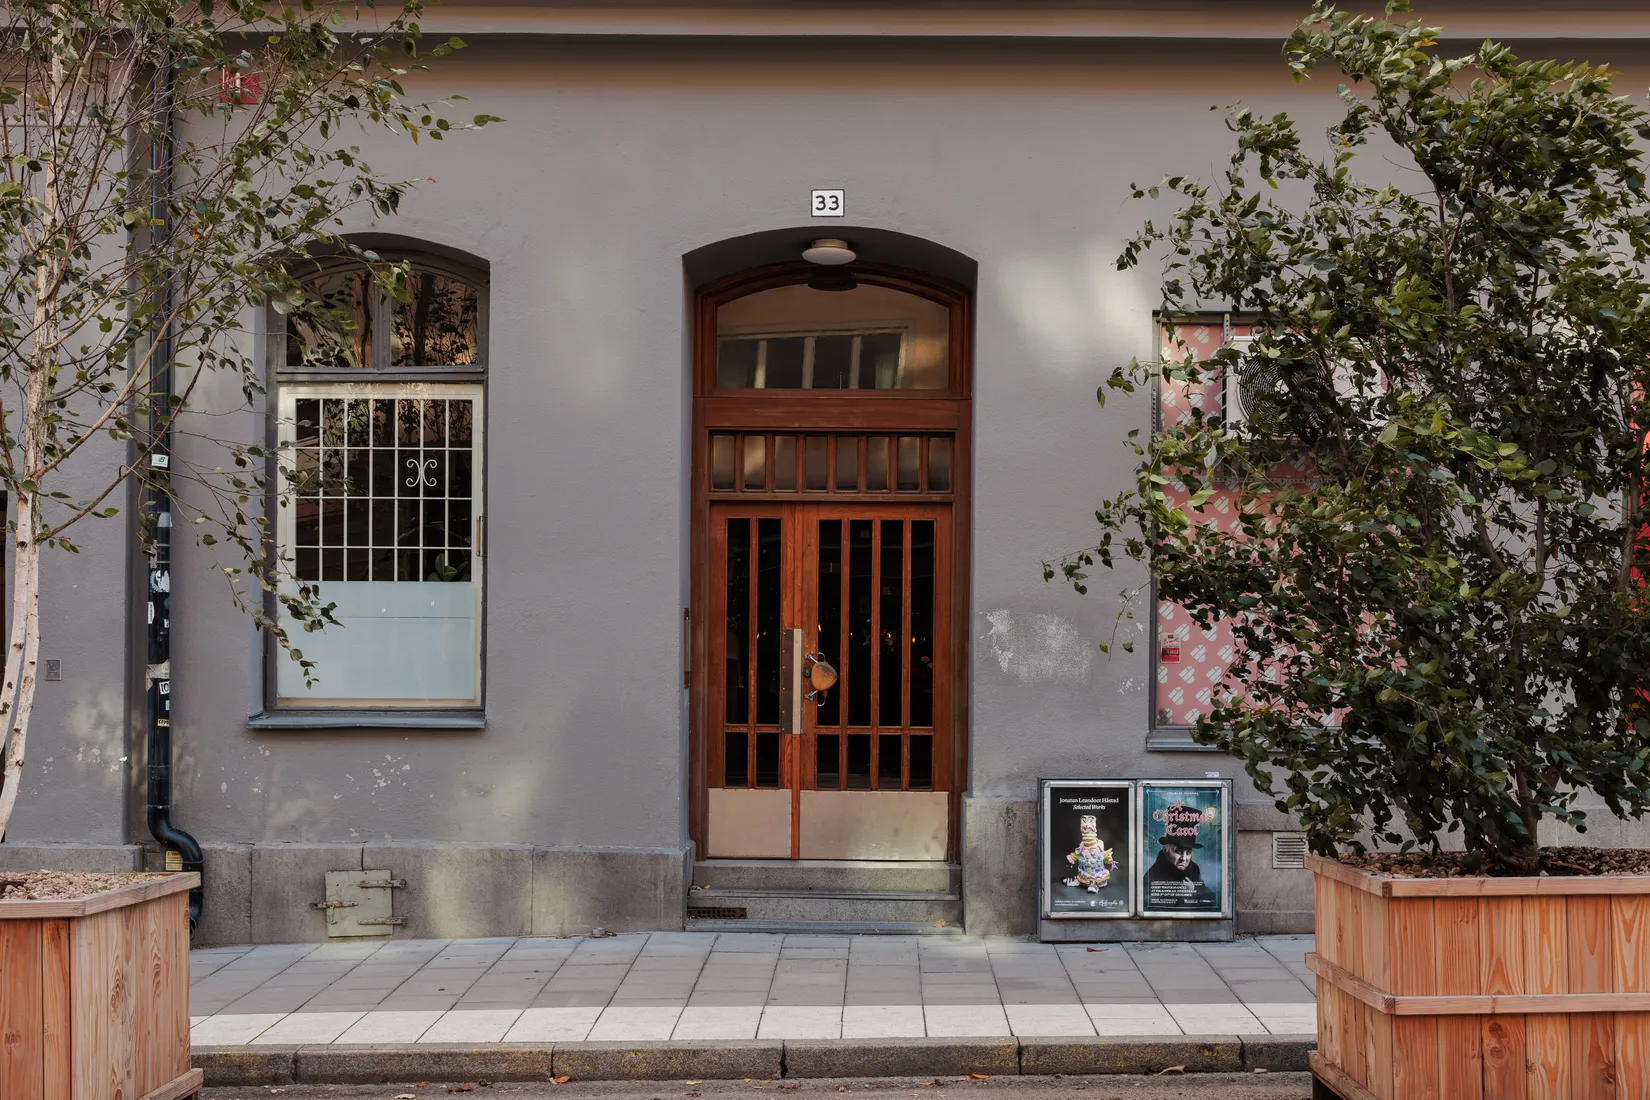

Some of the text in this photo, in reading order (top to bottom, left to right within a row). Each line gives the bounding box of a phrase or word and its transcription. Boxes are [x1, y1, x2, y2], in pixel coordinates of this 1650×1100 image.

[815, 195, 840, 211] 33
[1169, 800, 1183, 811] A
[1153, 809, 1213, 825] Christmas
[1166, 823, 1200, 836] Carol
